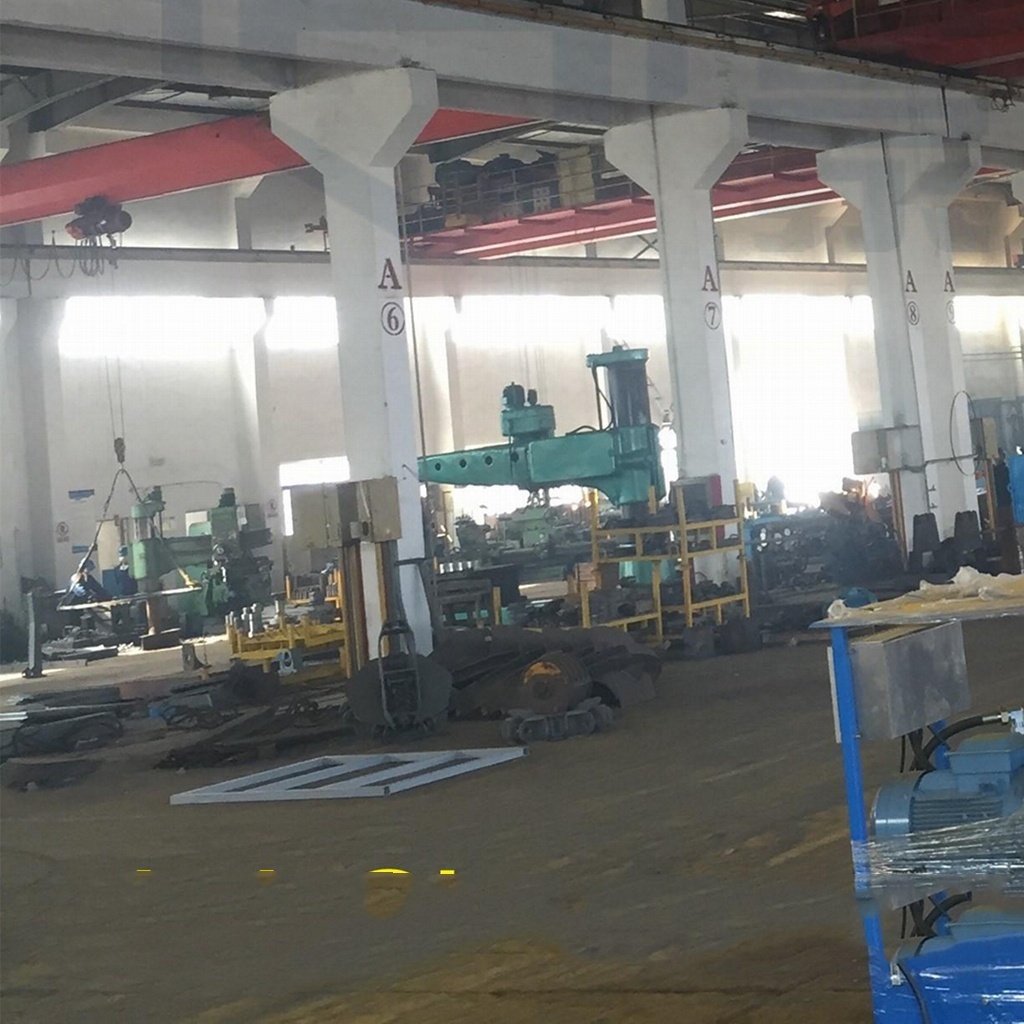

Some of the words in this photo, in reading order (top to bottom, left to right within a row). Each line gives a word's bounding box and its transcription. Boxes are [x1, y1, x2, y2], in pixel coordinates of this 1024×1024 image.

[378, 258, 402, 289] A
[701, 265, 719, 292] A
[905, 270, 918, 293] A
[943, 270, 955, 293] A
